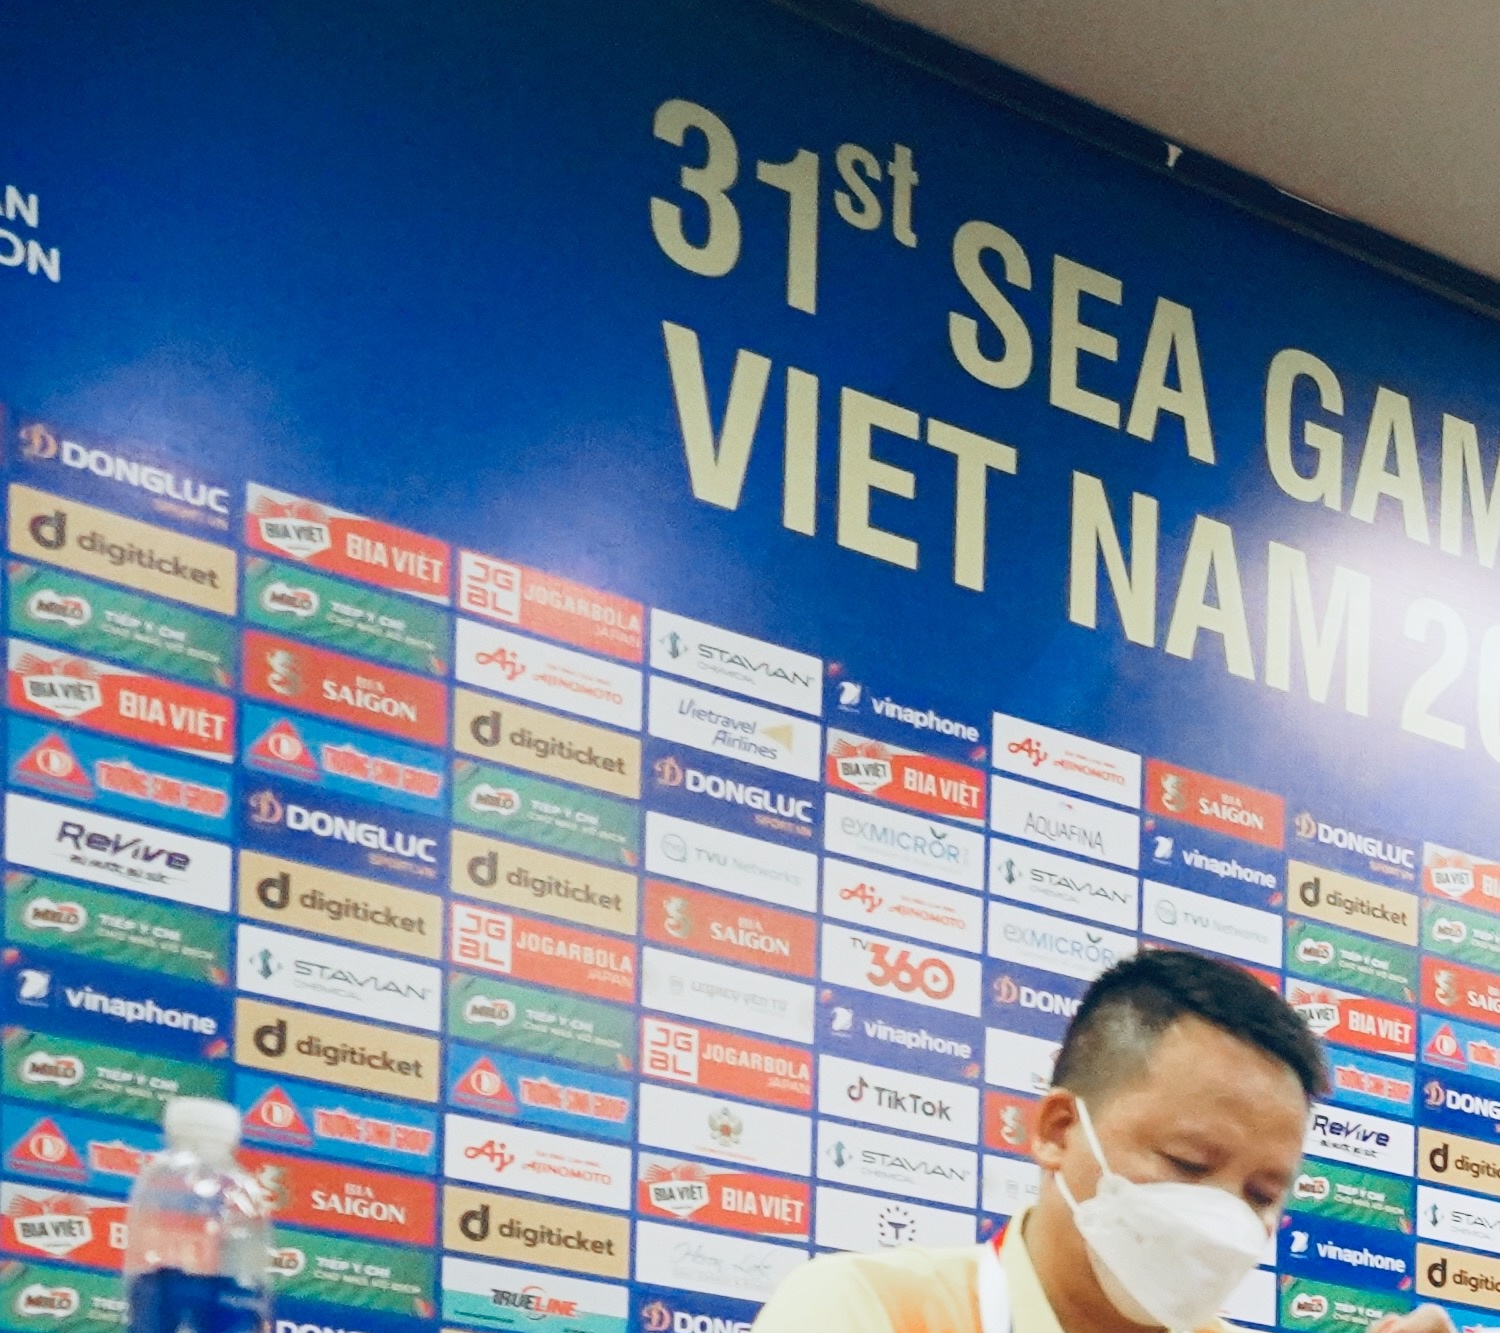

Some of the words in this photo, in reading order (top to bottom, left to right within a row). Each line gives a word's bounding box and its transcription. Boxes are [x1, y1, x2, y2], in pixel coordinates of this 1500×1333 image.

[651, 99, 918, 314] 31st
[949, 220, 1215, 464] SEA
[662, 320, 1017, 591] VIET
[1069, 470, 1370, 717] NAM
[76, 531, 218, 589] digiticket
[346, 533, 389, 570] BIA
[523, 581, 641, 635] JOGARBOLA
[119, 690, 166, 728] BIA
[872, 695, 978, 742] vinaphone
[509, 728, 626, 775] digiticket
[904, 767, 938, 797] BIA
[1182, 848, 1275, 888] vinaphone
[299, 889, 427, 935] digiticket
[1325, 890, 1407, 926] digiticket
[515, 929, 633, 975] JOGARBOLA
[65, 986, 216, 1036] vinaphone
[1348, 1010, 1376, 1036] BIA
[296, 1035, 423, 1078] digiticket
[864, 1018, 971, 1058] vinaphone
[701, 1040, 810, 1082] JOGARBOLA
[874, 1085, 951, 1121] TikTok
[722, 1186, 759, 1215] BIA
[498, 1218, 615, 1255] digiticket
[1316, 1239, 1404, 1272] vinaphone
